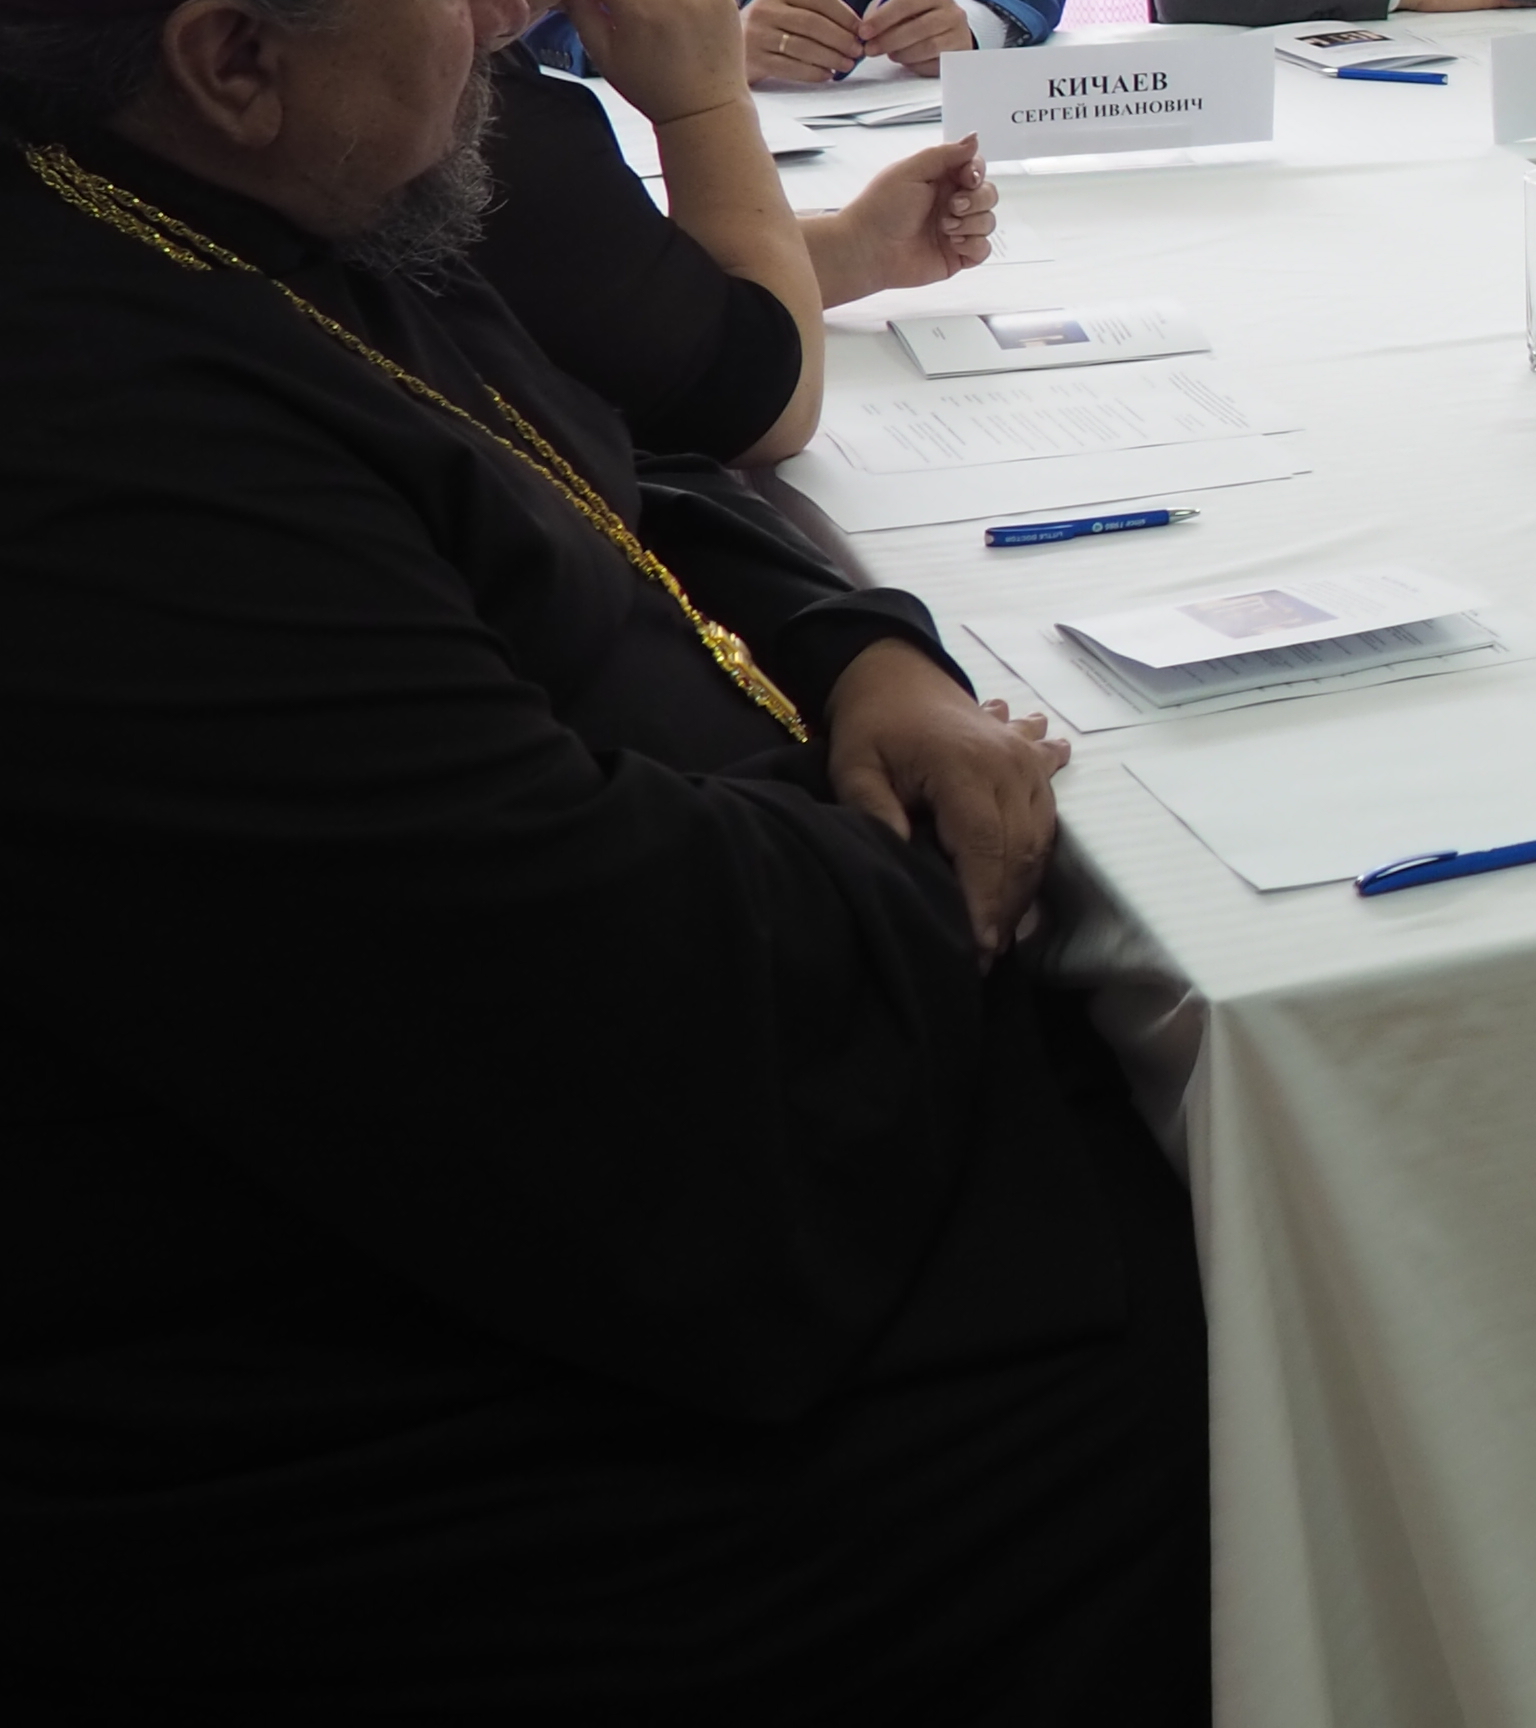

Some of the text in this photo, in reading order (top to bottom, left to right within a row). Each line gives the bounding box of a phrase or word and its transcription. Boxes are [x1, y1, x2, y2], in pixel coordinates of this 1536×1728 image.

[1047, 71, 1170, 98] КИЧАЕВ
[1011, 97, 1204, 125] СЕРГЕЙ ИВАНОВИЧ
